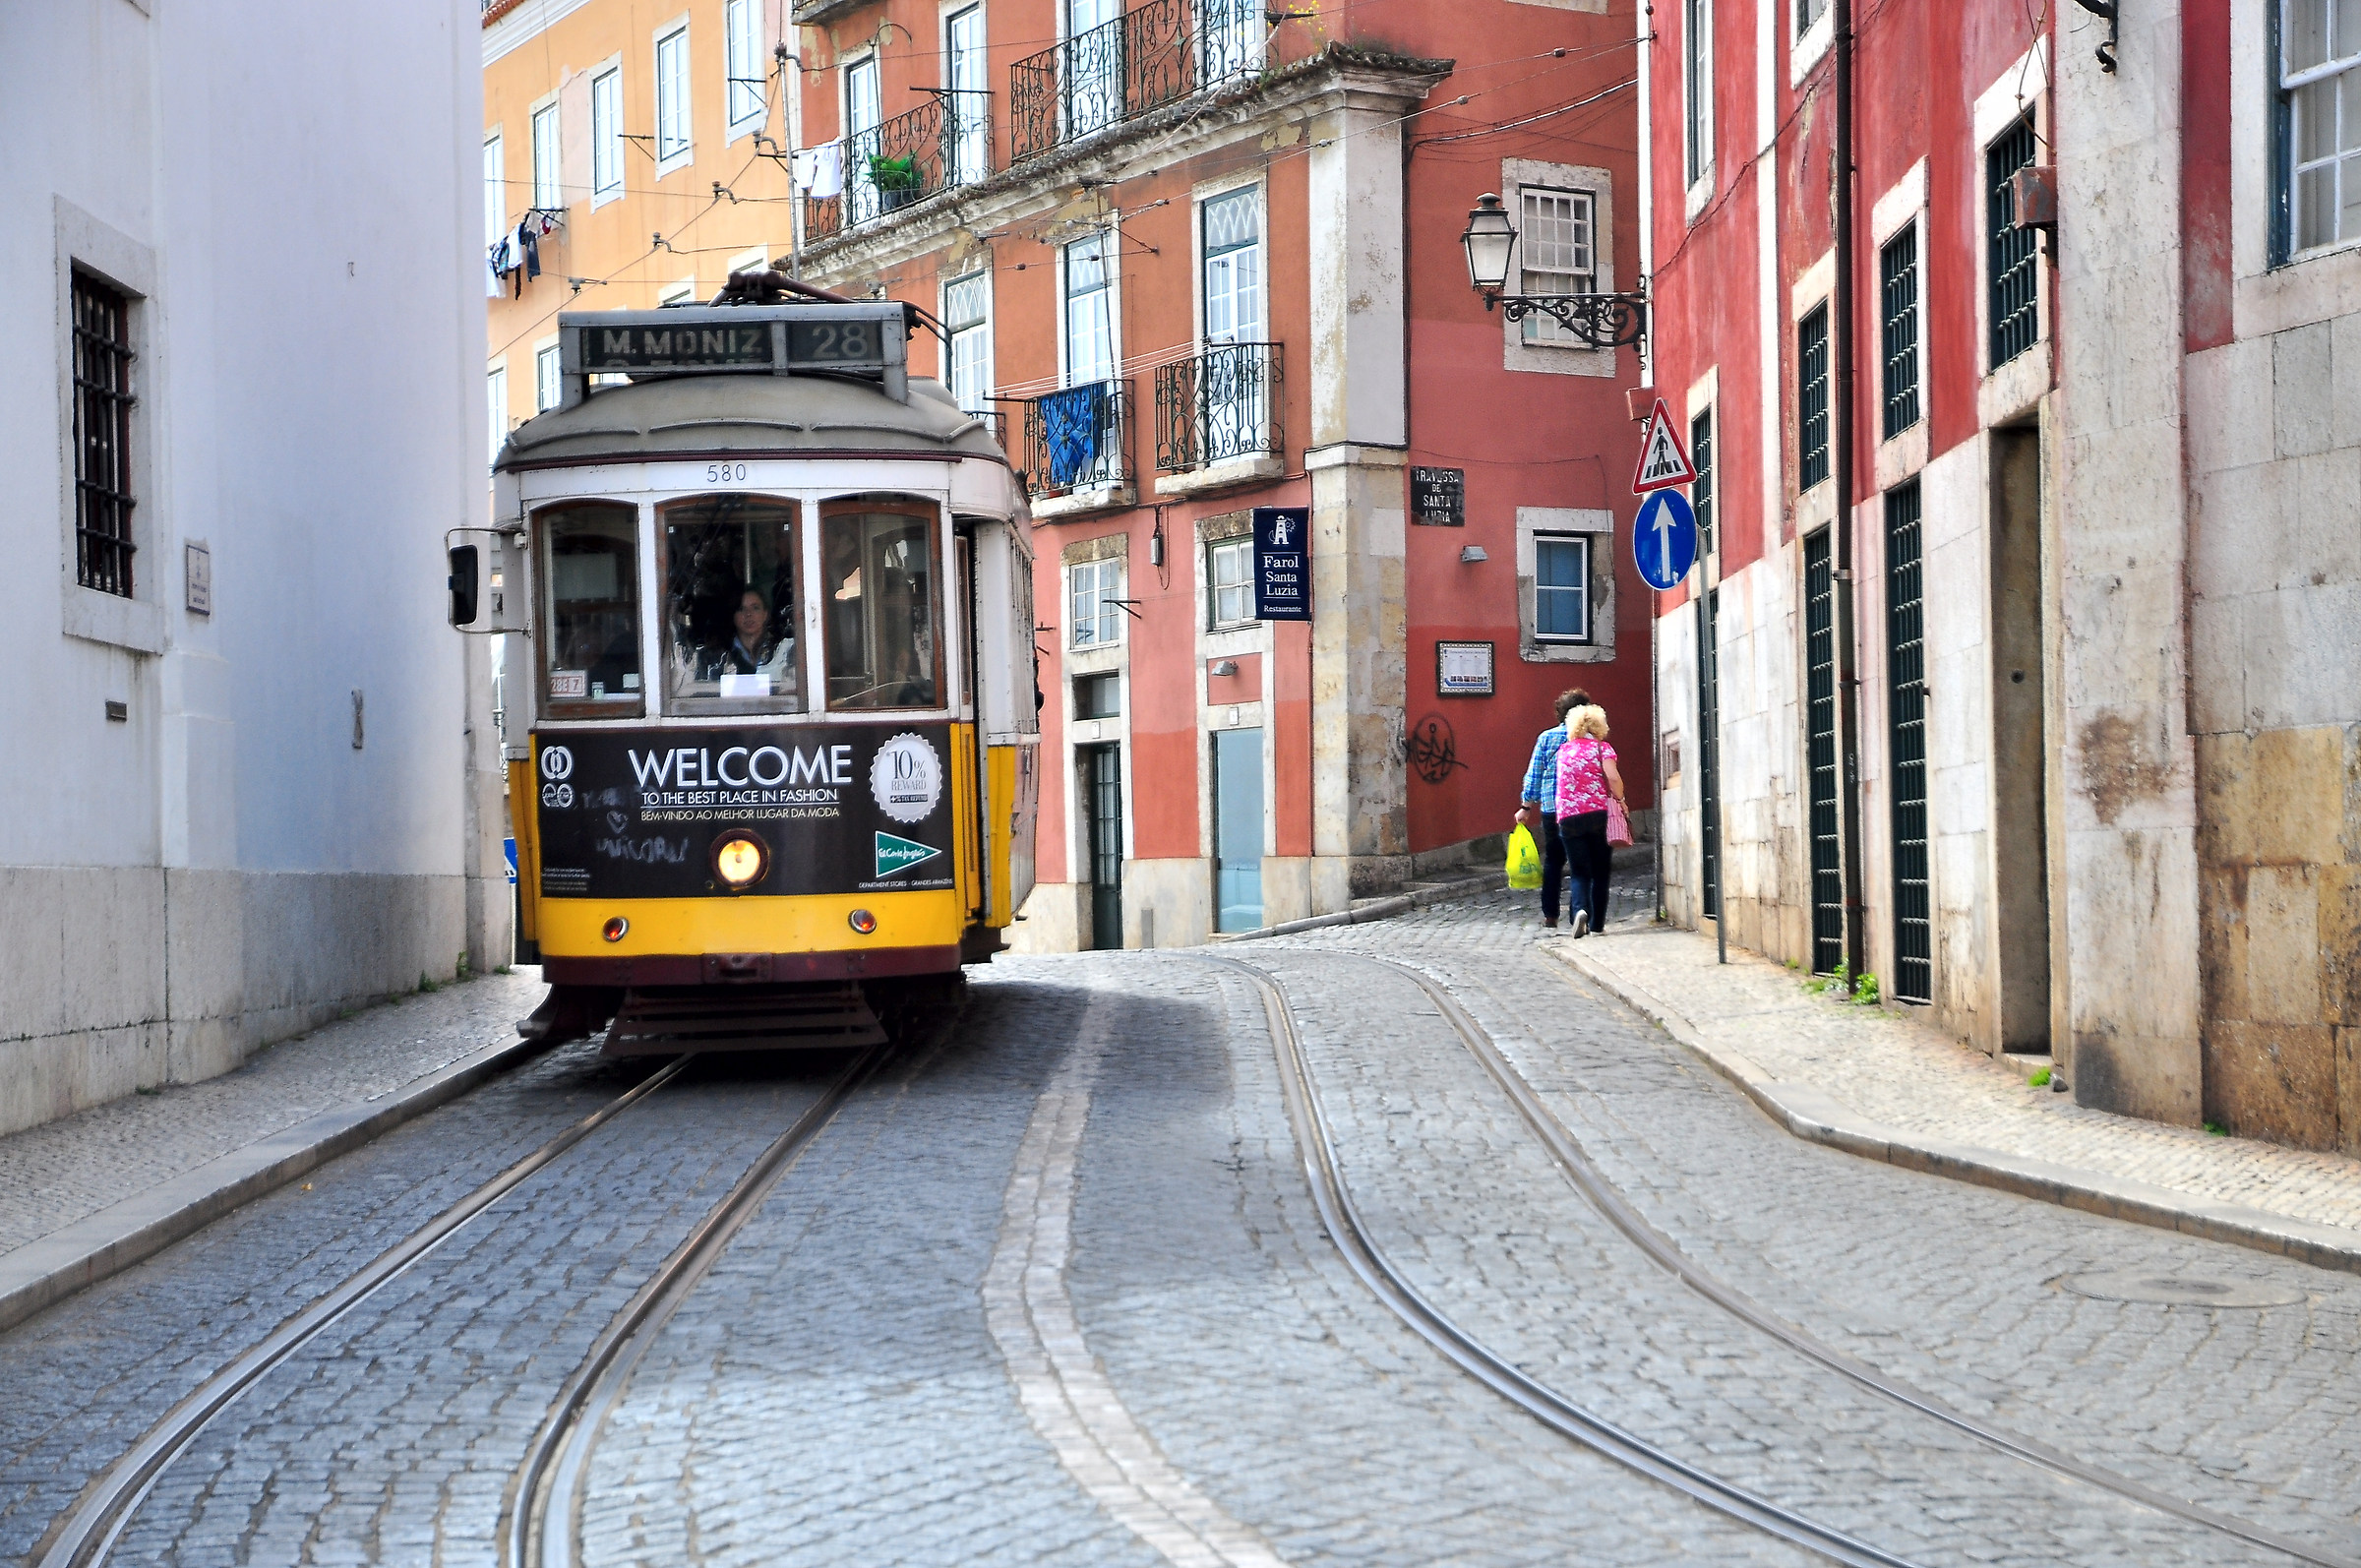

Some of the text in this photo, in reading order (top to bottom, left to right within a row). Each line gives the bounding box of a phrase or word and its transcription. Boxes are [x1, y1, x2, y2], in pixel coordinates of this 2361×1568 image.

[603, 329, 763, 355] M. MONIZ
[811, 323, 869, 359] 28
[706, 463, 747, 483] 580
[1431, 483, 1442, 493] DE
[1423, 494, 1452, 508] SANTA
[1263, 555, 1300, 569] Farol
[1265, 571, 1298, 582] Santa
[1265, 583, 1299, 596] Luzia
[1263, 604, 1302, 613] Restaurante
[628, 745, 852, 788] WELCOME
[890, 750, 927, 780] 10%
[890, 779, 927, 792] REWARD
[641, 792, 660, 806] TO
[661, 791, 685, 805] THE
[688, 791, 717, 805] BEST
[719, 790, 758, 804] PLACE
[761, 790, 777, 803] IN
[779, 788, 838, 803] FASHION
[640, 806, 840, 821] BEM-VINDO AO MELHOR LUGAR DA MODA
